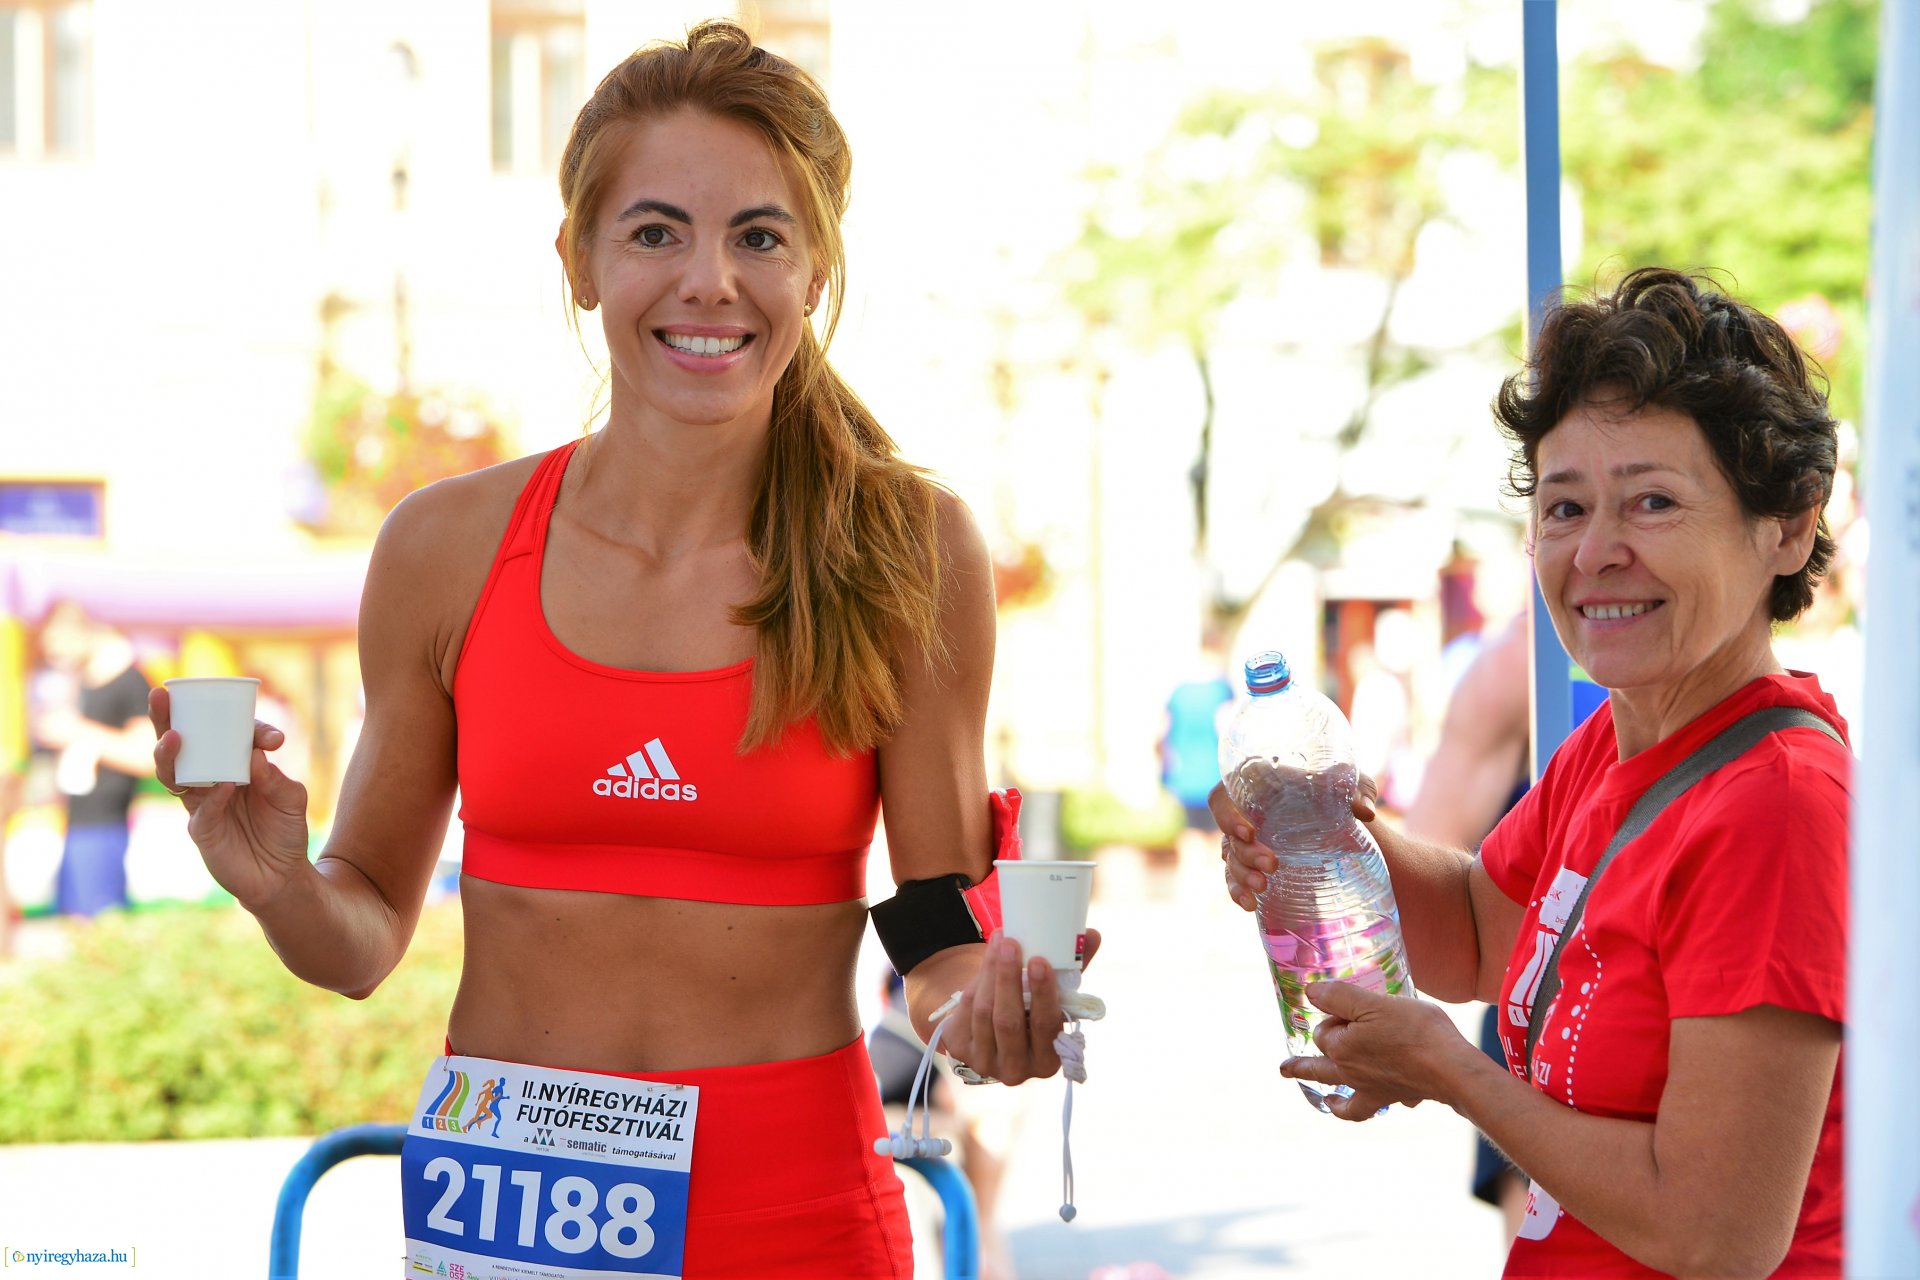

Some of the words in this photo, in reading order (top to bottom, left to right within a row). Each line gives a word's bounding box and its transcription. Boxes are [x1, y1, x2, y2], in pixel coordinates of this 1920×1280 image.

[592, 776, 698, 802] adidas
[426, 1118, 430, 1128] 1
[438, 1119, 444, 1129] 2
[451, 1120, 457, 1130] 3
[516, 1103, 685, 1142] FUTÓFESZTIVÁL
[566, 1138, 607, 1153] sematic
[612, 1146, 677, 1161] támogatásával
[423, 1156, 656, 1259] 21188
[449, 1263, 465, 1274] SZE
